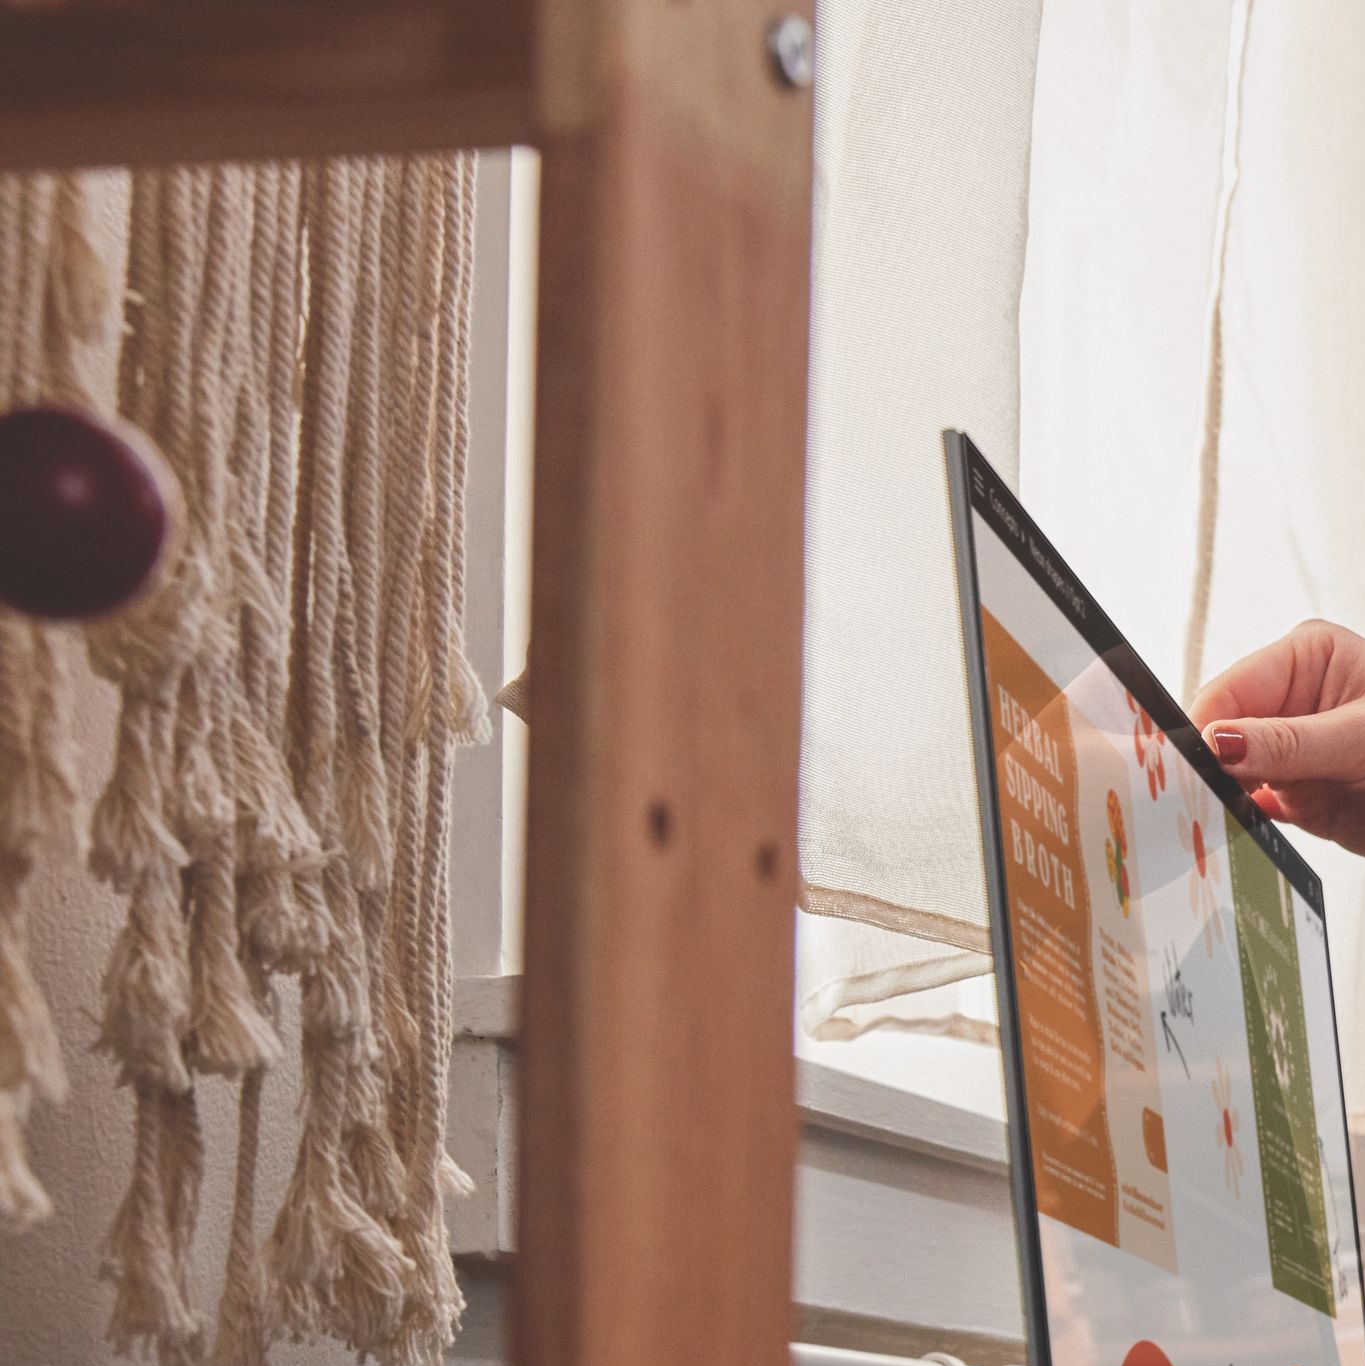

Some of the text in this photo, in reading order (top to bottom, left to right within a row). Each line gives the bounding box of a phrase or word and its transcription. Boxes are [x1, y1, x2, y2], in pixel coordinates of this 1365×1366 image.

[998, 683, 1063, 784] HERBAL
[1004, 752, 1069, 846] SIPPING
[1011, 818, 1076, 910] BROTH
